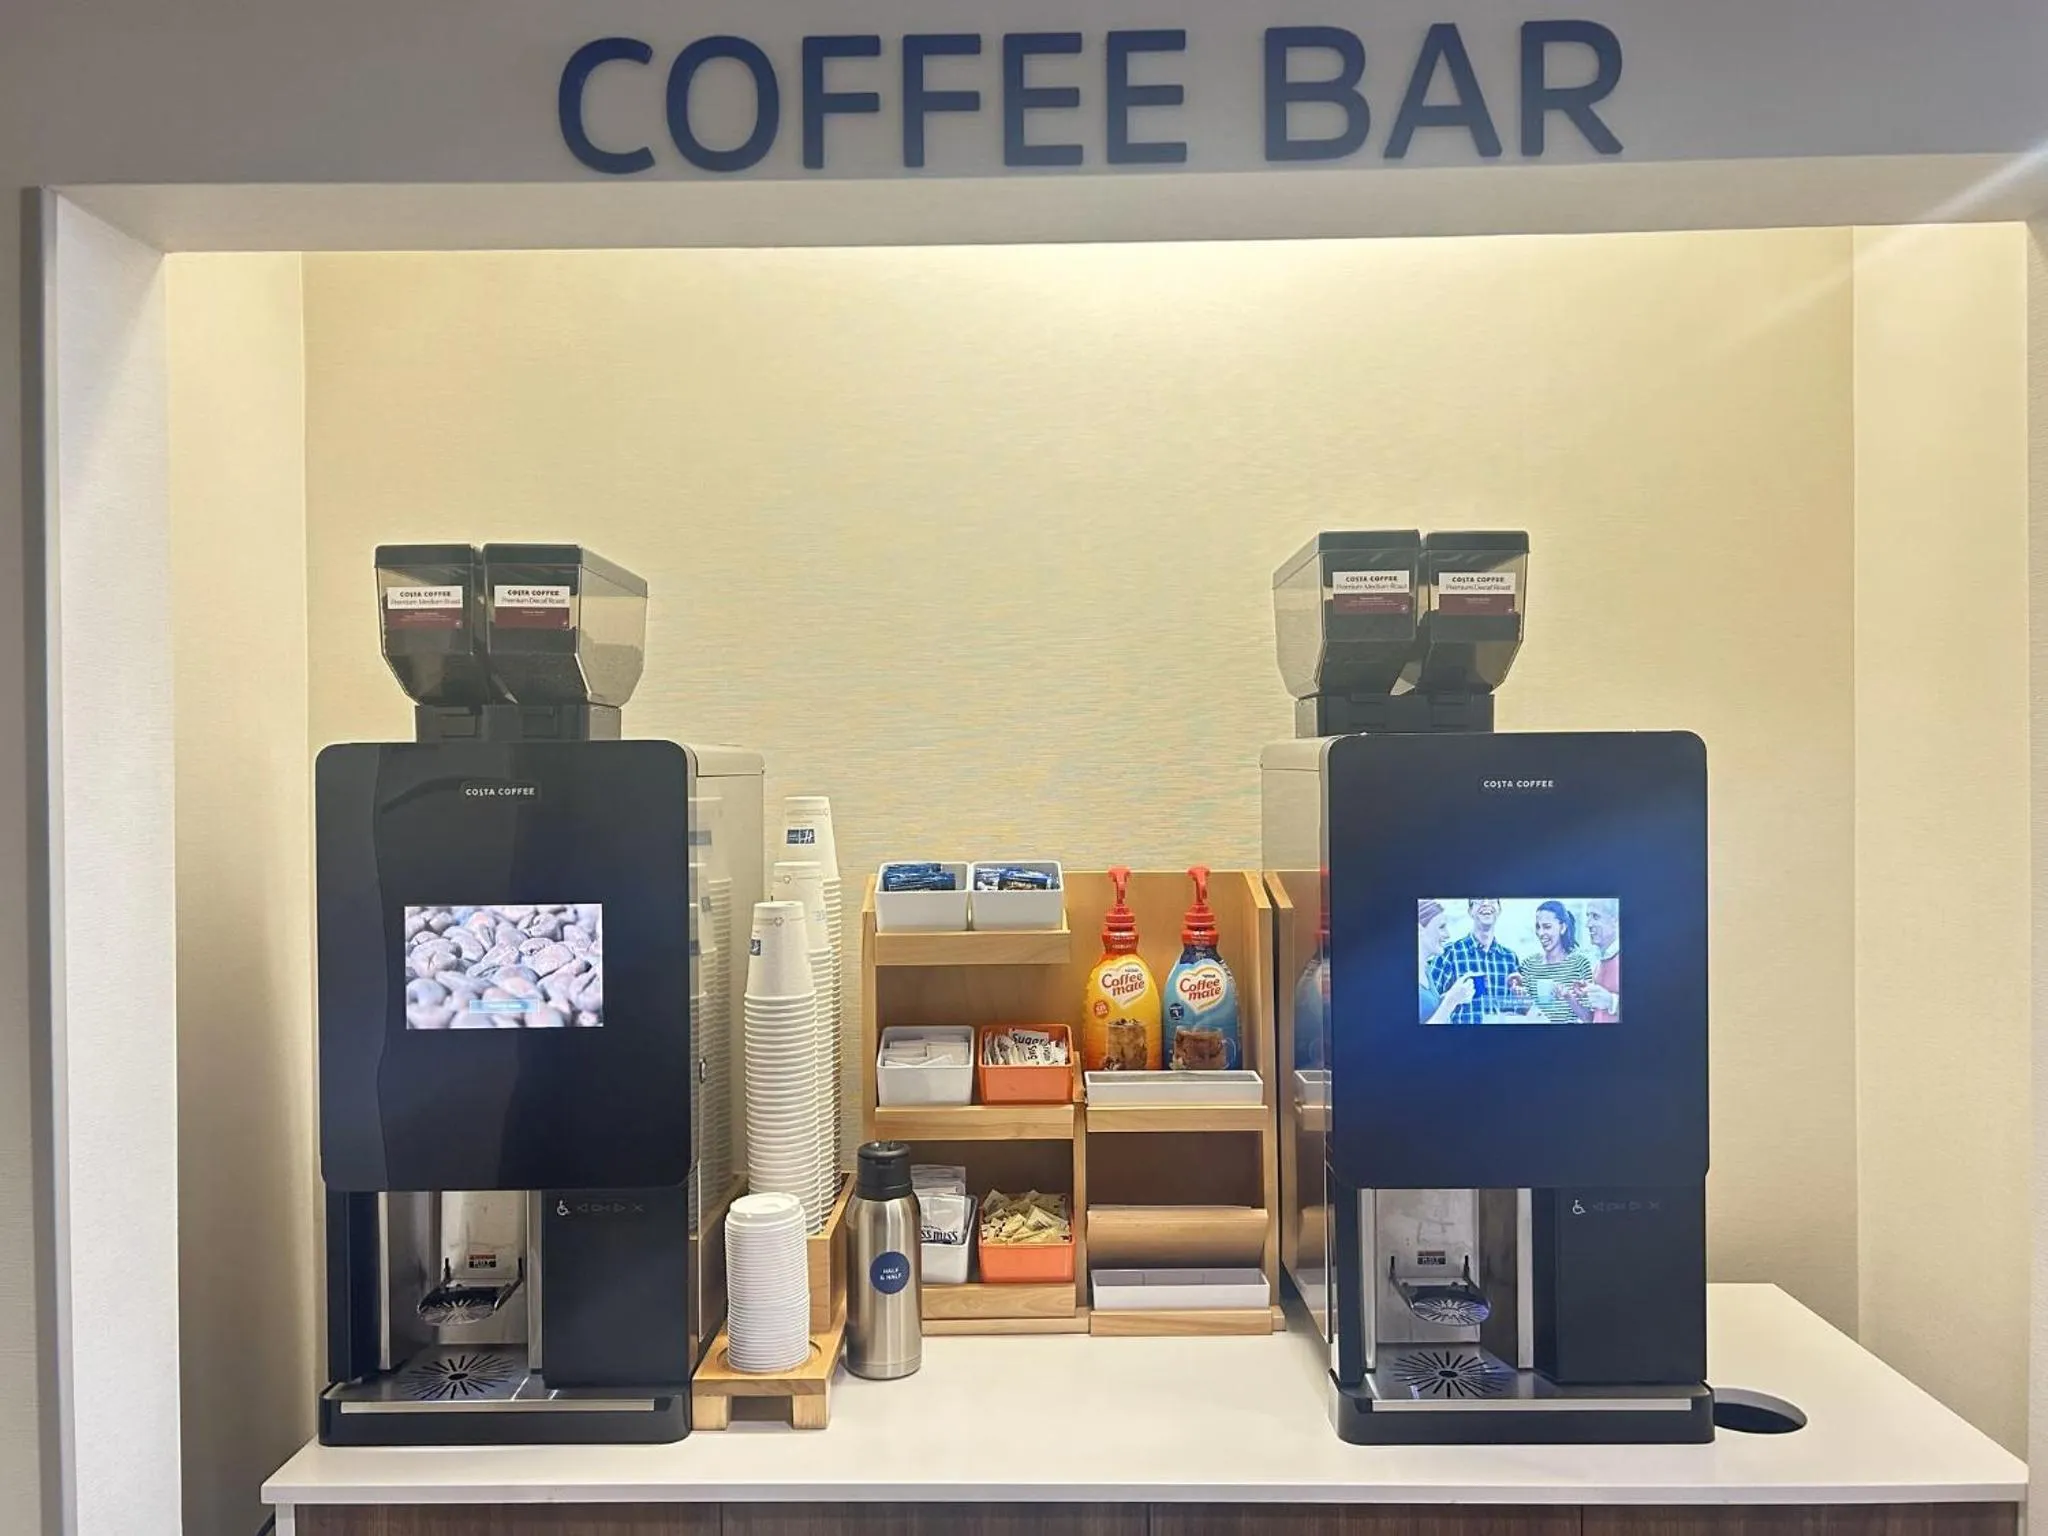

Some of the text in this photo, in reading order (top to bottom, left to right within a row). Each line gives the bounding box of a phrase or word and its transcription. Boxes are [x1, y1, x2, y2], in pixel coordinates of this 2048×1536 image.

[557, 18, 1625, 174] COFFEE BAR
[465, 787, 535, 796] COSTA COFFEE
[1483, 780, 1554, 788] COSTA COFFEE
[1101, 972, 1143, 988] Coffee
[1180, 977, 1220, 993] Coffee
[1112, 981, 1145, 997] mate
[1188, 986, 1221, 1000] mate
